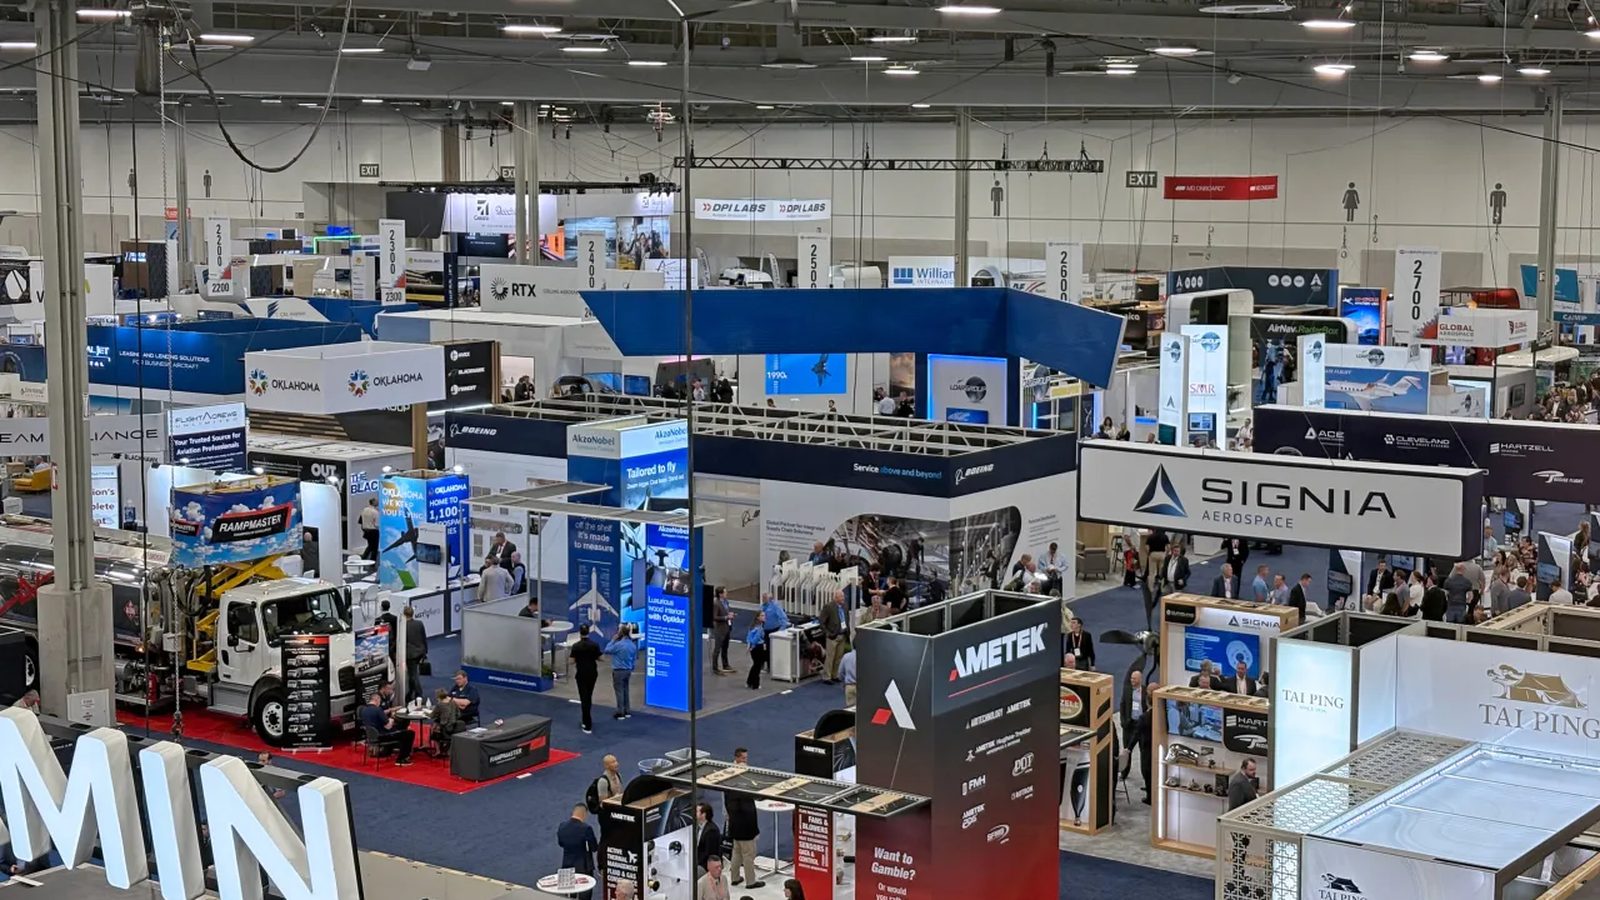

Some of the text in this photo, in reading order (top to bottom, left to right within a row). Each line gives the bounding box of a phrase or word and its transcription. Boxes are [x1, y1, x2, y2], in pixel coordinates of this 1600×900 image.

[361, 165, 378, 176] EXIT
[1129, 174, 1156, 186] EXIT
[712, 203, 766, 213] DPI LABS
[787, 203, 826, 213] DPI LABS
[388, 229, 396, 275] 2300
[212, 283, 230, 293] 2200
[511, 283, 537, 297] RTX
[1411, 260, 1422, 320] 2700
[385, 291, 402, 303] 2300
[1439, 323, 1474, 332] GLOBAL
[372, 372, 423, 387] OKLAHOMA
[271, 379, 320, 393] OKLAHOMA
[1190, 383, 1215, 394] SMR
[461, 426, 497, 437] BOEING
[655, 427, 687, 440] AkzoNobe
[1318, 430, 1345, 439] ACE
[175, 432, 241, 448] Your Trusted Source for
[572, 434, 615, 446] AkzoNobel
[1396, 436, 1449, 445] CLEVELAND
[176, 443, 240, 456] Aviation Professionals
[1500, 443, 1554, 453] HARTZELL
[311, 463, 337, 477] OUT
[627, 462, 677, 478] Tailored to fly
[853, 463, 879, 473] Service
[901, 469, 915, 477] and
[915, 469, 942, 480] beyond
[965, 464, 994, 477] BOEING
[92, 488, 115, 496] ion's
[351, 480, 379, 495] BLAC
[434, 483, 467, 495] OKLAHOMA
[429, 496, 458, 507] HOME TO
[1202, 477, 1397, 519] SIGNIA
[219, 514, 282, 533] RAMPMASTER
[1202, 509, 1293, 529] AEROSPACE
[575, 521, 613, 532] off the shelf
[577, 530, 610, 542] it's made
[574, 540, 614, 553] to measure
[648, 596, 674, 607] Luxurious
[648, 605, 686, 616] wood interiors
[648, 613, 662, 621] with
[1241, 617, 1280, 629] SIGNIA
[950, 625, 1047, 681] AMETEK
[1060, 699, 1080, 708] ZELL
[1282, 688, 1345, 709] TAI PING
[1006, 698, 1032, 714] AMETEK
[1237, 715, 1268, 727] HART
[1479, 704, 1600, 741] TAI PING
[489, 748, 522, 763] RAMPMASTER
[968, 775, 986, 790] FMH
[808, 816, 823, 825] FANS
[802, 823, 828, 833] BLOWERS
[607, 846, 623, 855] ACTIVE
[798, 841, 824, 852] SENSORS
[607, 854, 628, 863] THERMAL
[874, 847, 913, 865] Want to
[607, 861, 638, 872] MANAGEMENT
[871, 862, 916, 880] Gamble?
[607, 868, 621, 876] FLUID
[626, 871, 637, 879] GAS
[878, 882, 907, 896] Or would
